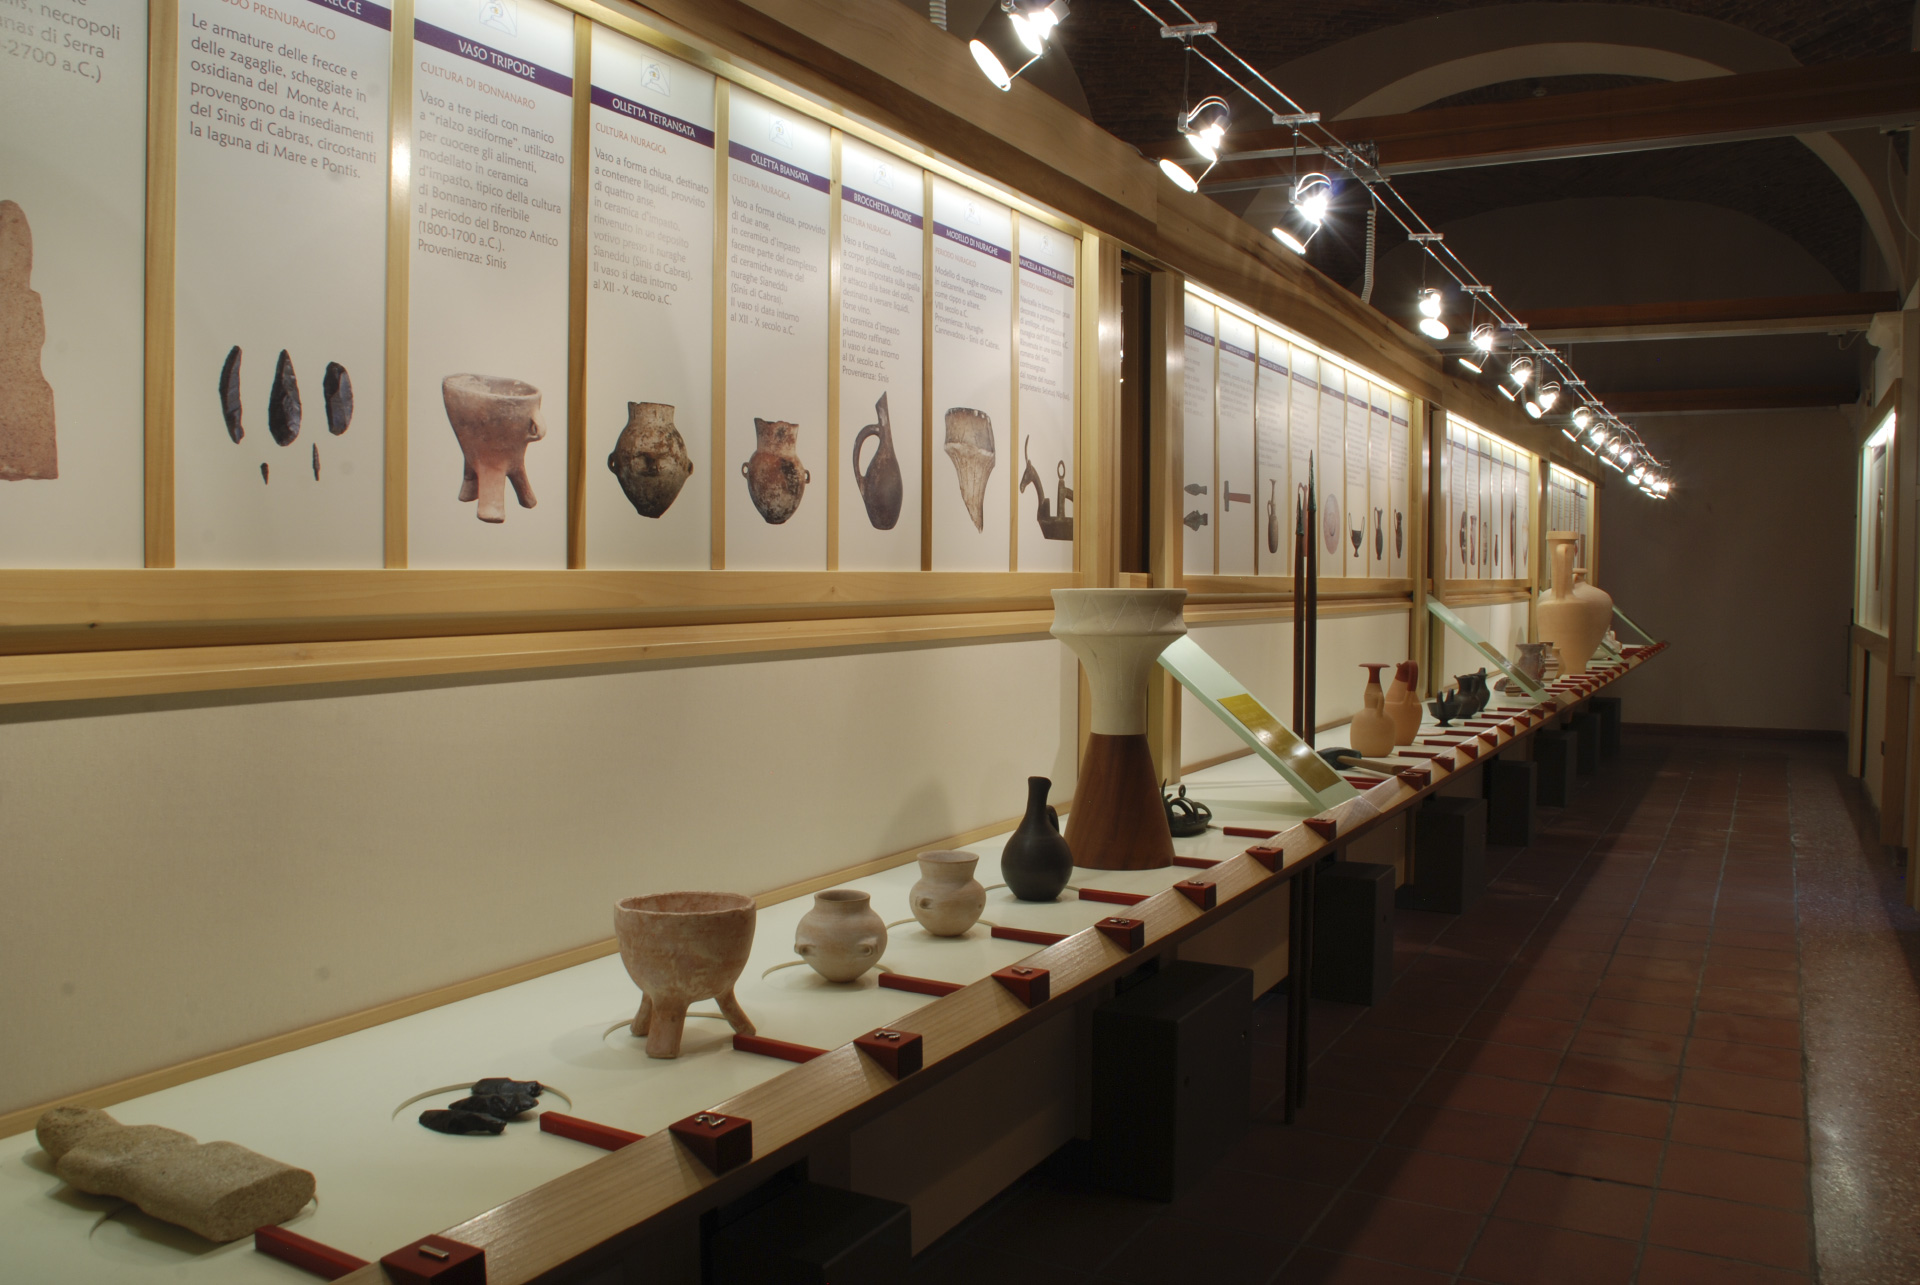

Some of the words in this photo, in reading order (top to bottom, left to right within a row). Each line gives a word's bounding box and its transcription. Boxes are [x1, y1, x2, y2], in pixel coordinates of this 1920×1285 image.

[40, 5, 120, 40] necropoli
[253, 4, 335, 40] PRENURAGICO
[40, 26, 57, 44] di
[63, 32, 104, 58] Serra
[192, 12, 207, 30] Le
[211, 23, 273, 52] armature
[277, 43, 308, 63] delle
[312, 54, 347, 76] frecce
[350, 70, 358, 80] e
[458, 39, 487, 60] VASO
[490, 51, 535, 79] TRIPODE
[62, 59, 101, 83] a.C.)
[191, 36, 225, 58] delle
[229, 50, 286, 78] zagaglie,
[291, 70, 352, 98] scheggiate
[356, 88, 366, 103] in
[420, 61, 463, 84] CULTURA
[466, 76, 475, 89] DI
[478, 81, 535, 109] BONNANARO
[190, 60, 253, 87] ossidiana
[257, 78, 277, 95] del
[286, 86, 328, 110] Monte
[331, 101, 359, 120] Arci,
[190, 81, 275, 115] provengono
[279, 105, 295, 120] da
[299, 110, 373, 143] insediamenti
[419, 89, 445, 108] Vaso
[447, 102, 454, 111] a
[457, 103, 471, 117] tre
[474, 109, 498, 125] piedi
[500, 119, 518, 132] con
[521, 125, 554, 144] manico
[612, 98, 646, 118] OLLETTA
[648, 111, 695, 137] TETRANSATA
[189, 101, 211, 118] del
[216, 107, 245, 127] Sinis
[249, 117, 262, 132] di
[266, 121, 313, 147] Cabras,
[317, 137, 376, 163] circostanti
[190, 120, 202, 137] la
[207, 125, 251, 150] laguna
[256, 140, 269, 154] di
[273, 143, 307, 164] Mare
[310, 157, 318, 168] e
[322, 156, 360, 178] Pontis.
[419, 111, 426, 120] a
[523, 144, 564, 164] utilizzato
[595, 122, 629, 141] CULTURA
[630, 134, 666, 155] NURAGICA
[418, 147, 472, 171] modellato
[475, 161, 484, 175] in
[487, 168, 528, 187] ceramica
[419, 129, 437, 142] per
[439, 136, 479, 155] cuocere
[481, 146, 493, 161] gli
[496, 151, 536, 173] alimenti,
[750, 153, 779, 171] OLLETTA
[780, 164, 809, 182] BIANSATA
[594, 146, 614, 163] Vaso
[615, 157, 621, 165] a
[623, 156, 647, 174] forma
[649, 166, 674, 183] chiusa,
[675, 175, 709, 194] destinato
[594, 166, 599, 175] a
[601, 168, 641, 187] contenere
[643, 178, 669, 197] liquidi,
[671, 190, 705, 208] provvisto
[732, 173, 760, 189] CULTURA
[760, 183, 790, 200] NURAGICA
[418, 183, 428, 196] di
[432, 185, 488, 211] Bonnanaro
[490, 202, 530, 222] riferibile
[476, 180, 503, 198] tipico
[505, 188, 528, 205] della
[531, 197, 561, 214] cultura
[594, 180, 602, 191] di
[604, 185, 635, 201] quattro
[594, 195, 602, 208] in
[603, 201, 639, 219] ceramica
[854, 192, 889, 213] BROCCHETTA
[418, 202, 427, 214] al
[430, 207, 472, 225] periodo
[474, 216, 489, 230] del
[492, 219, 527, 239] Bronzo
[529, 230, 558, 247] Antico
[593, 213, 633, 233] rinvenuto
[731, 194, 748, 209] Vaso
[749, 203, 754, 211] a
[755, 202, 775, 218] forma
[776, 211, 796, 226] chiusa,
[797, 220, 826, 235] provvisto
[731, 210, 738, 220] di
[739, 213, 753, 225] due
[754, 219, 771, 232] anse,
[842, 213, 866, 228] CULTURA
[418, 220, 476, 244] (1800-1700
[478, 236, 504, 253] a.C.).
[593, 231, 620, 245] votivo
[656, 248, 686, 264] nuraghe
[731, 224, 738, 234] in
[739, 229, 768, 244] ceramica
[946, 229, 969, 244] MODELLO
[975, 240, 997, 255] NURAGHE
[418, 238, 482, 264] Provenienza:
[485, 253, 506, 269] Sinis
[593, 244, 630, 264] Sianeddu
[632, 255, 652, 270] (Sinis
[653, 261, 661, 272] di
[662, 263, 693, 281] Cabras).
[731, 238, 755, 254] facente
[756, 248, 774, 260] parte
[775, 252, 785, 263] del
[785, 257, 817, 273] complesso
[592, 278, 600, 289] al
[602, 280, 614, 292] XII
[622, 284, 629, 295] X
[631, 289, 656, 302] secolo
[657, 294, 672, 305] a.C.
[600, 265, 620, 278] vaso
[621, 269, 628, 280] si
[629, 270, 647, 284] data
[649, 275, 678, 292] intorno
[730, 270, 758, 284] nuraghe
[842, 364, 876, 380] Provenienza:
[877, 372, 889, 383] Sinis
